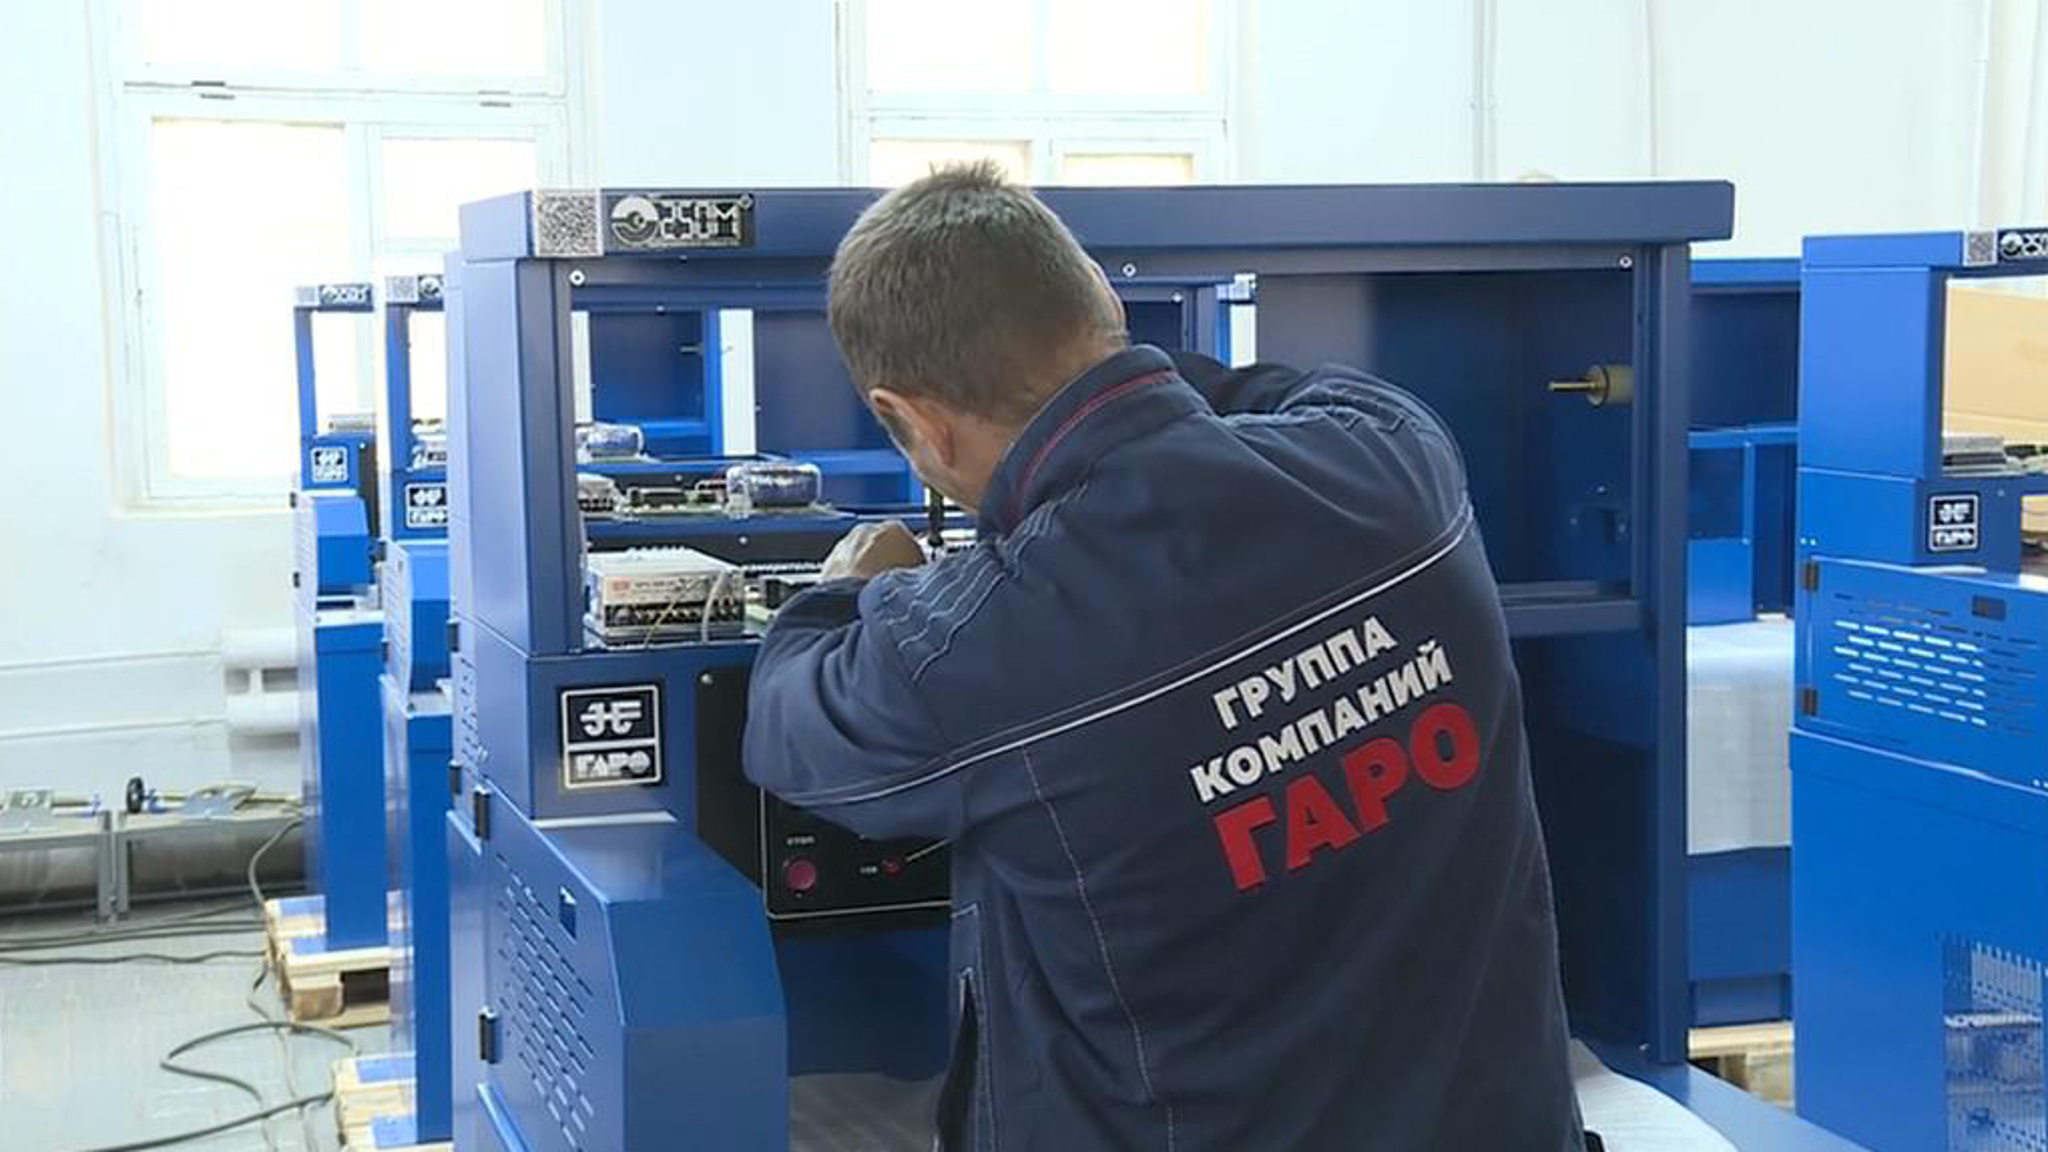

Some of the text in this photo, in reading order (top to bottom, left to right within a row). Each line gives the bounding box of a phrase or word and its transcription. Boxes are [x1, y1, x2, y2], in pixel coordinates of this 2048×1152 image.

[1189, 639, 1453, 803] КОМПАНИЙ
[1213, 616, 1397, 730] ГРУППА
[574, 751, 651, 779] ГАРО
[1214, 702, 1481, 891] ГАРО
